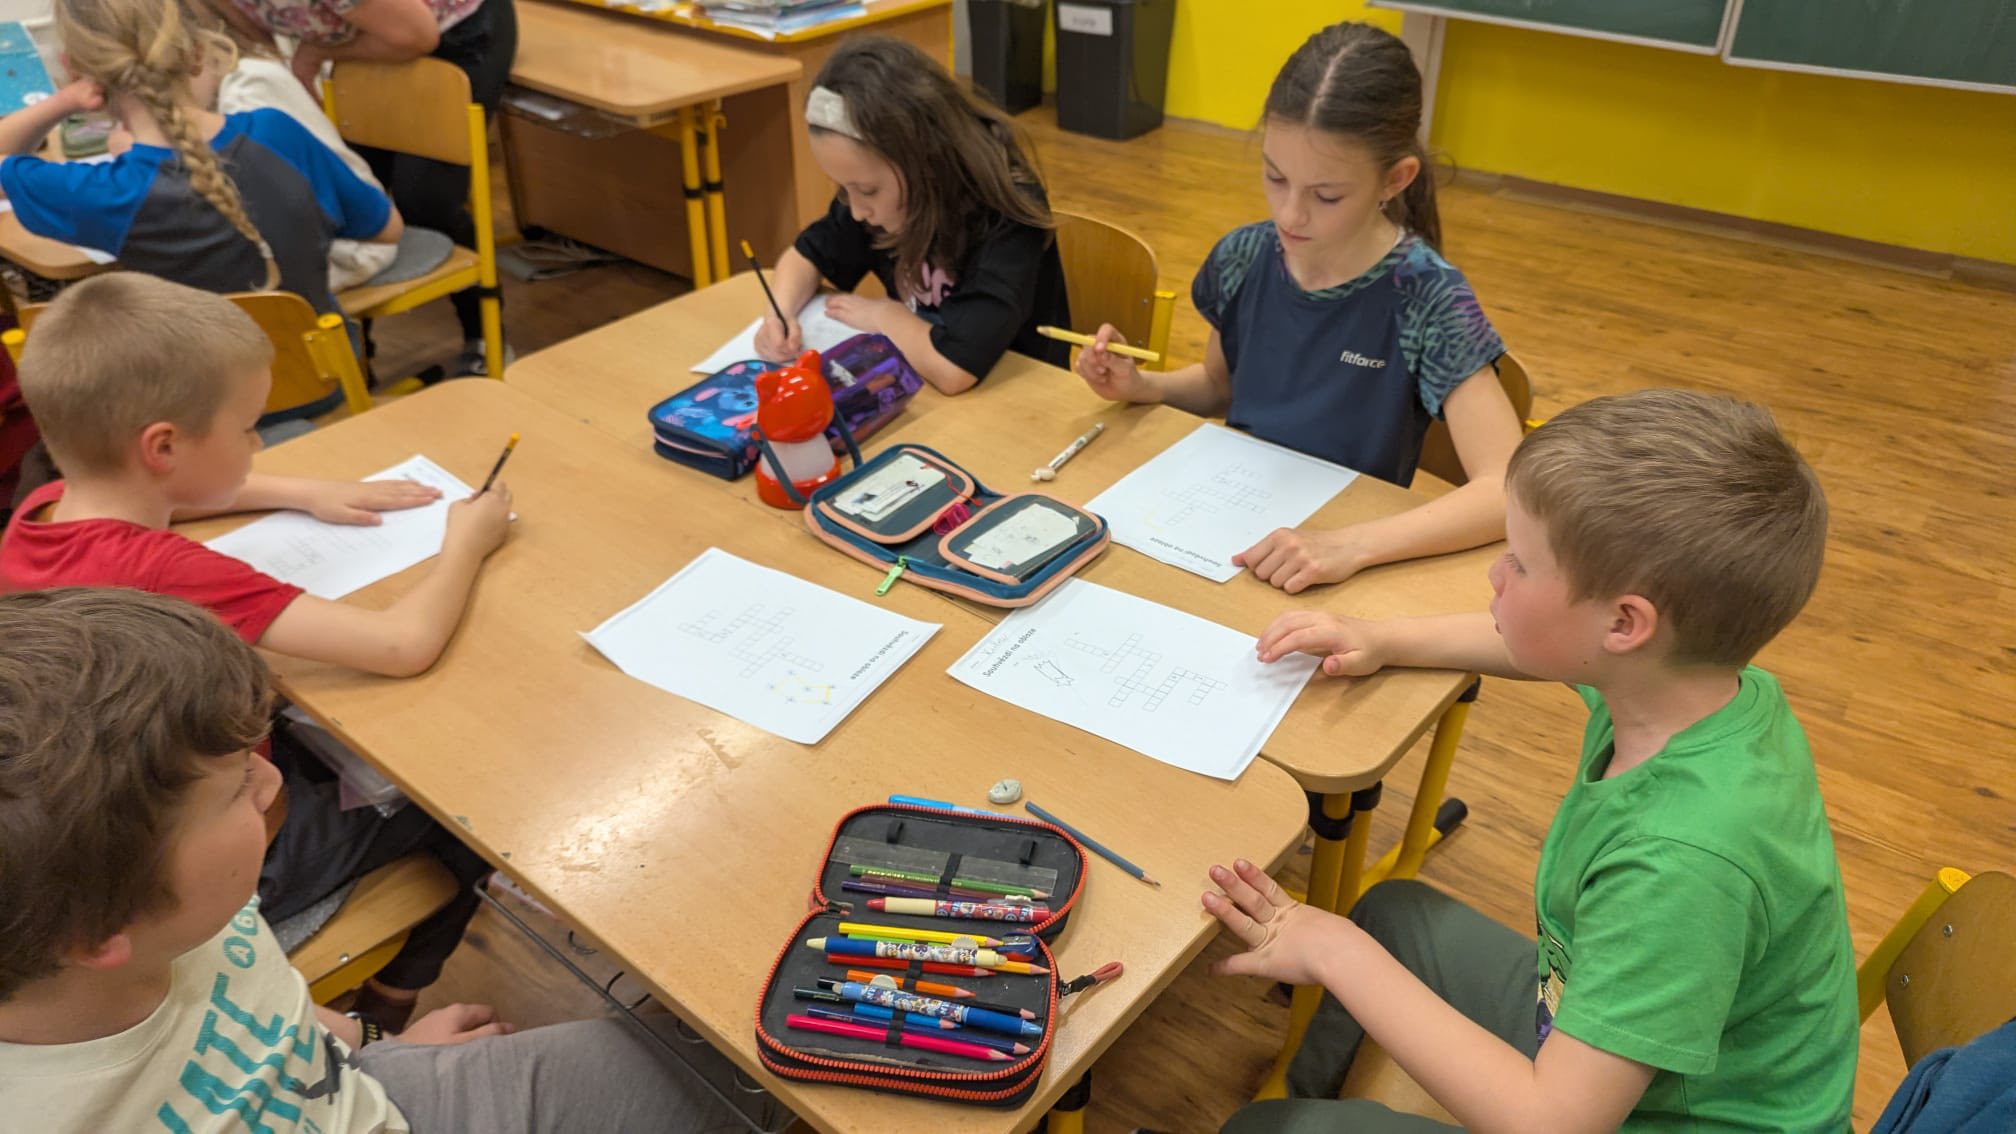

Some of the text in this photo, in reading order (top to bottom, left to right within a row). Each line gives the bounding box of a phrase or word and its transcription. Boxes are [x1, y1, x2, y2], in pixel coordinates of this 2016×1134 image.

[1340, 350, 1386, 368] fitforce
[1010, 641, 1021, 652] na
[1017, 627, 1037, 644] obloze
[157, 971, 316, 1134] ATE
